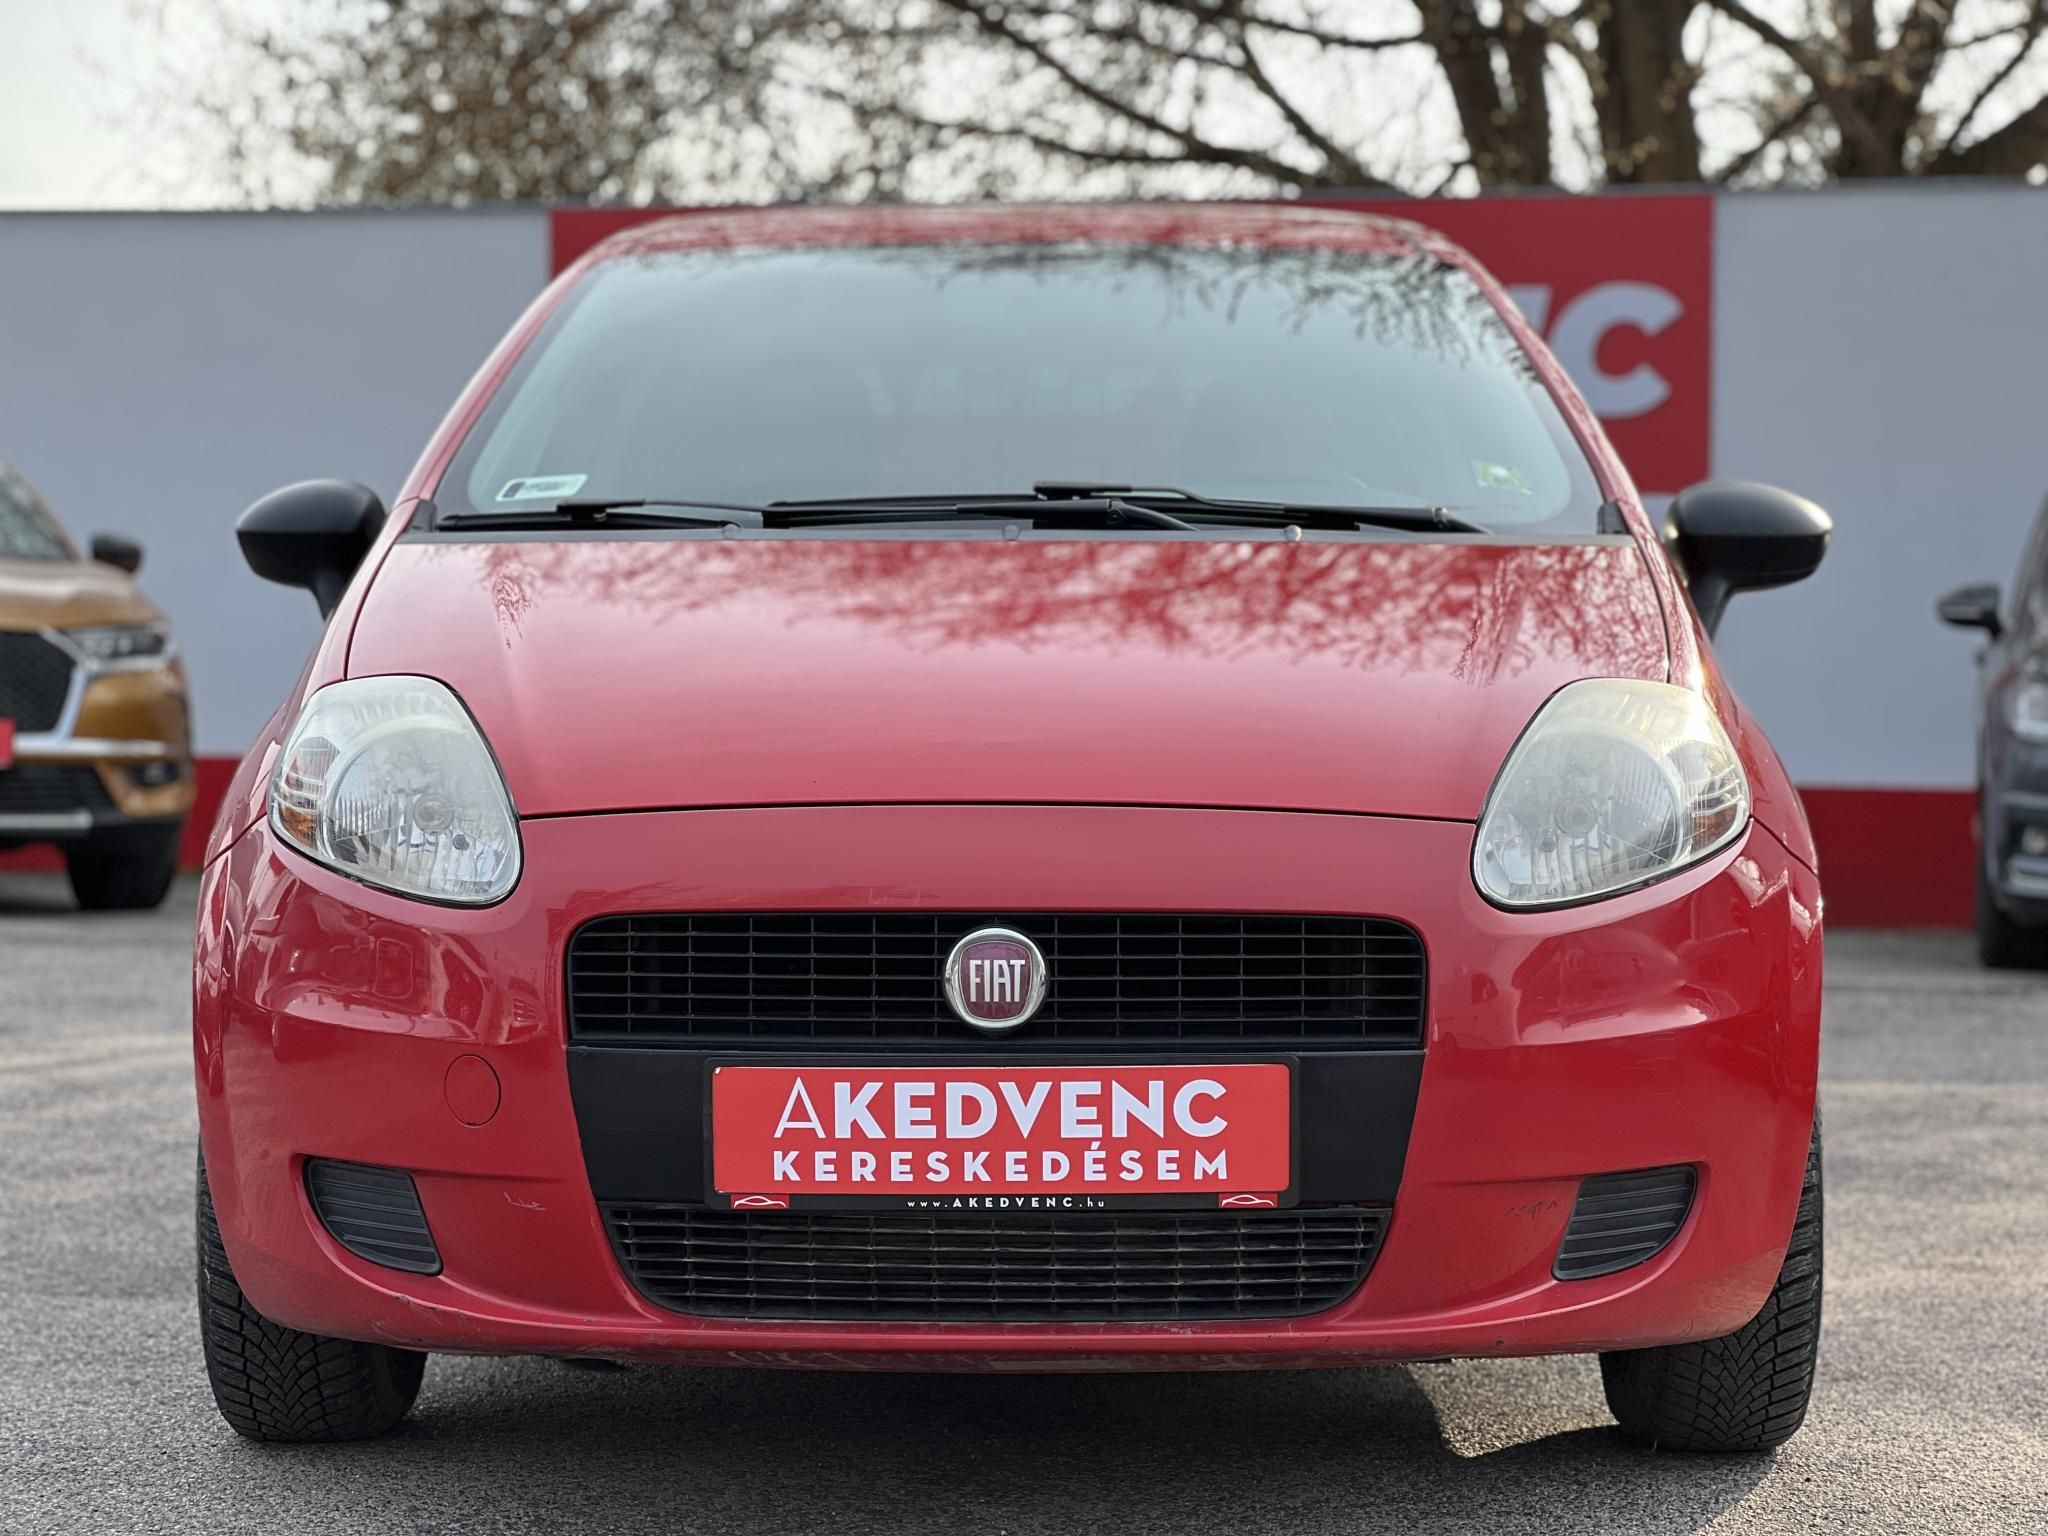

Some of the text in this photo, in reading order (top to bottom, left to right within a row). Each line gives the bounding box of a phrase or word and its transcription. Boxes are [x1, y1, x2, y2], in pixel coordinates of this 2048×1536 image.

[1501, 284, 1684, 418] C
[969, 960, 1025, 1002] FIAT
[773, 1141, 1228, 1182] KERESKEDÉSEM
[907, 1196, 1105, 1208] www.AKEDVENC.hu
